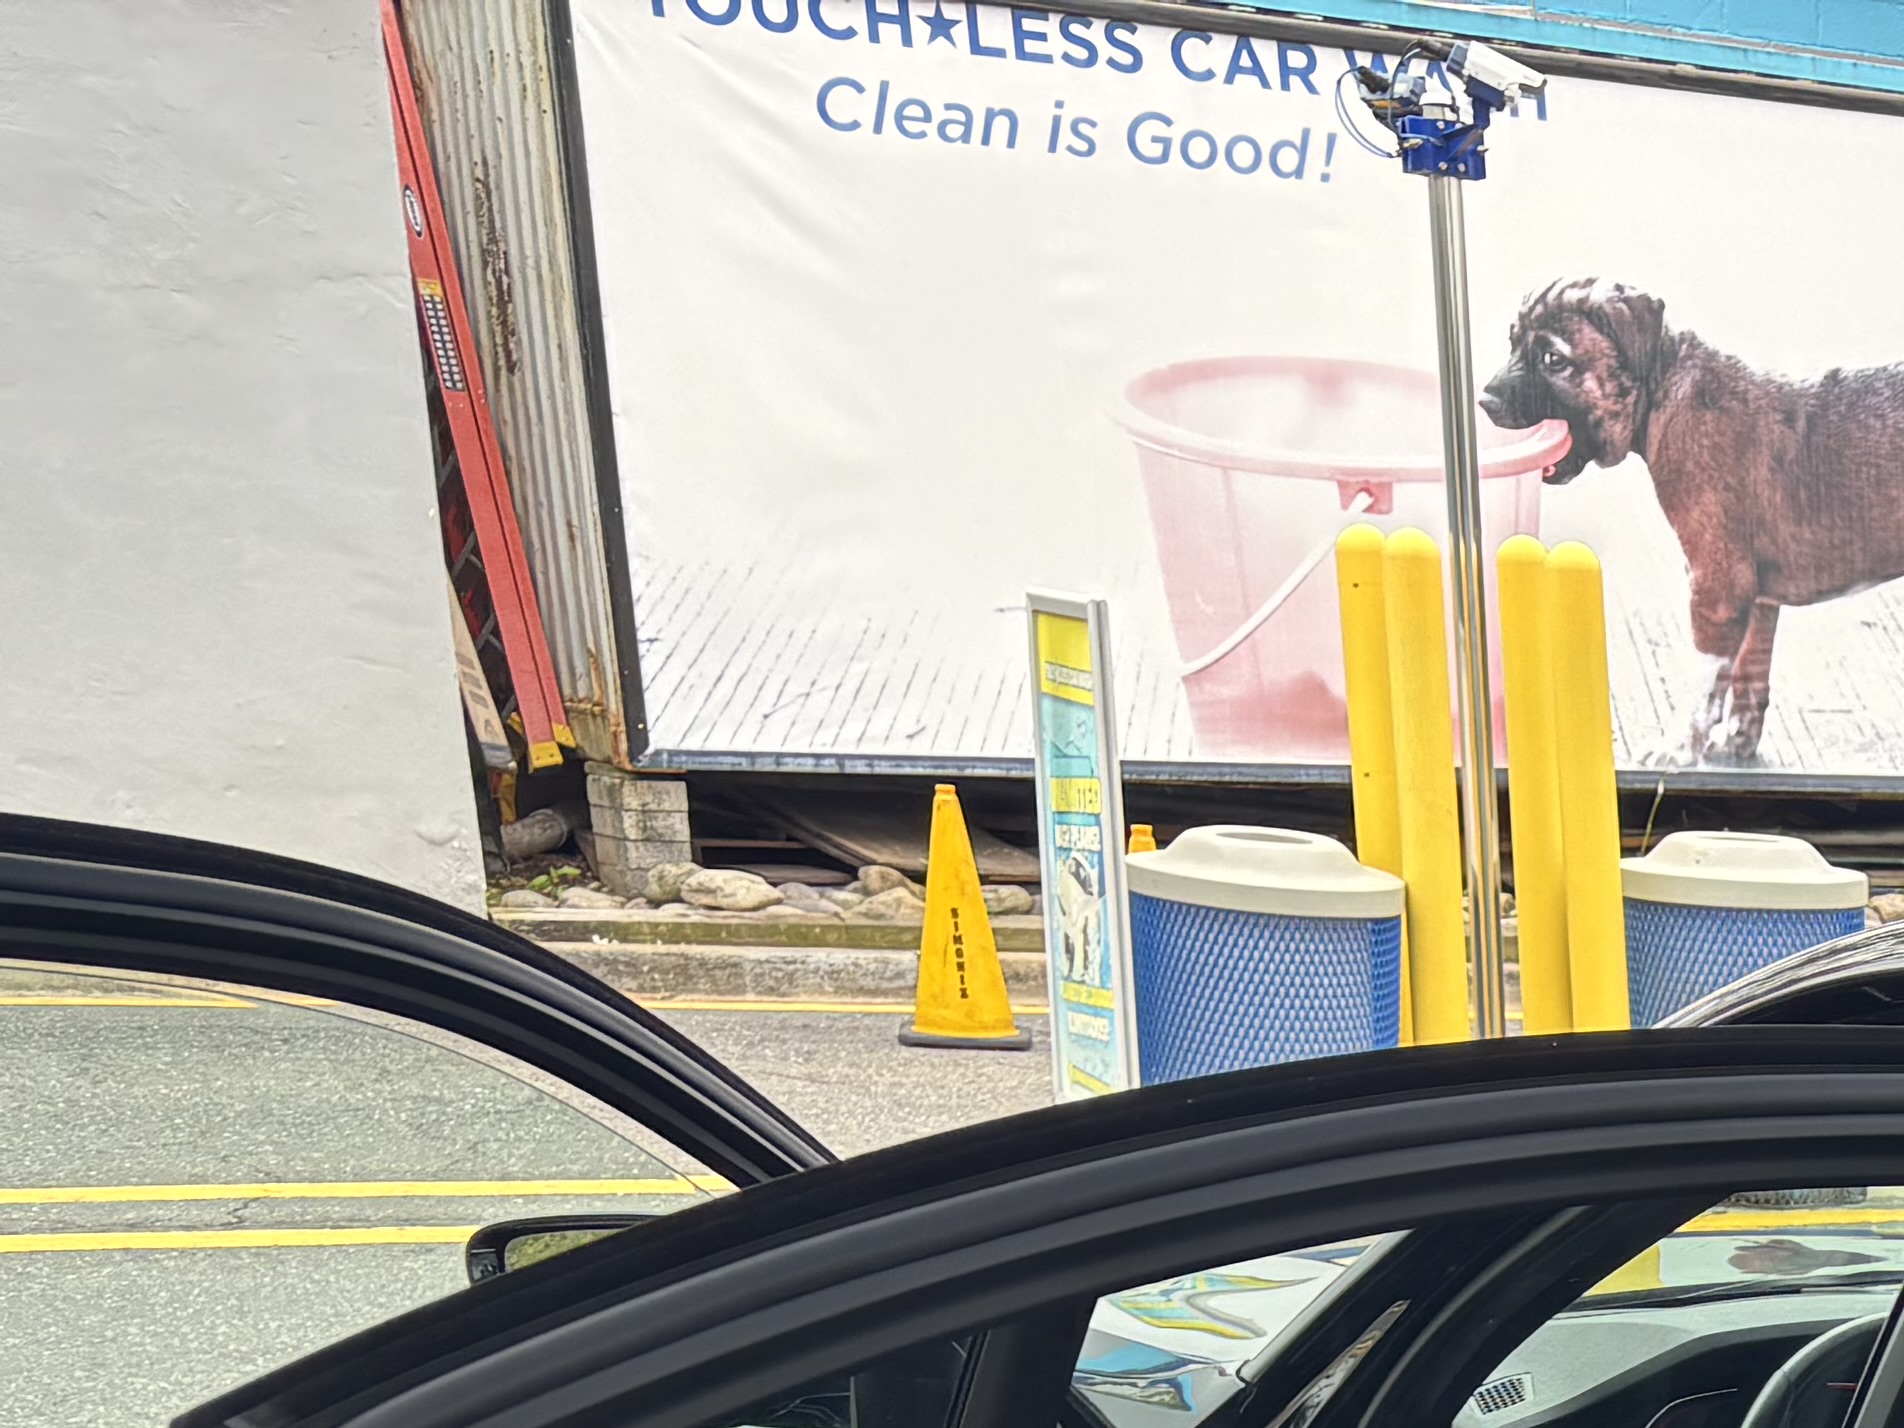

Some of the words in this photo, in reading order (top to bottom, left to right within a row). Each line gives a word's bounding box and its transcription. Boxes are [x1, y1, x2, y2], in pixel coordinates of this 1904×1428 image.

[1170, 29, 1321, 96] CAR
[816, 76, 1020, 150] Clean
[1047, 99, 1098, 158] is
[1126, 111, 1338, 184] Good!
